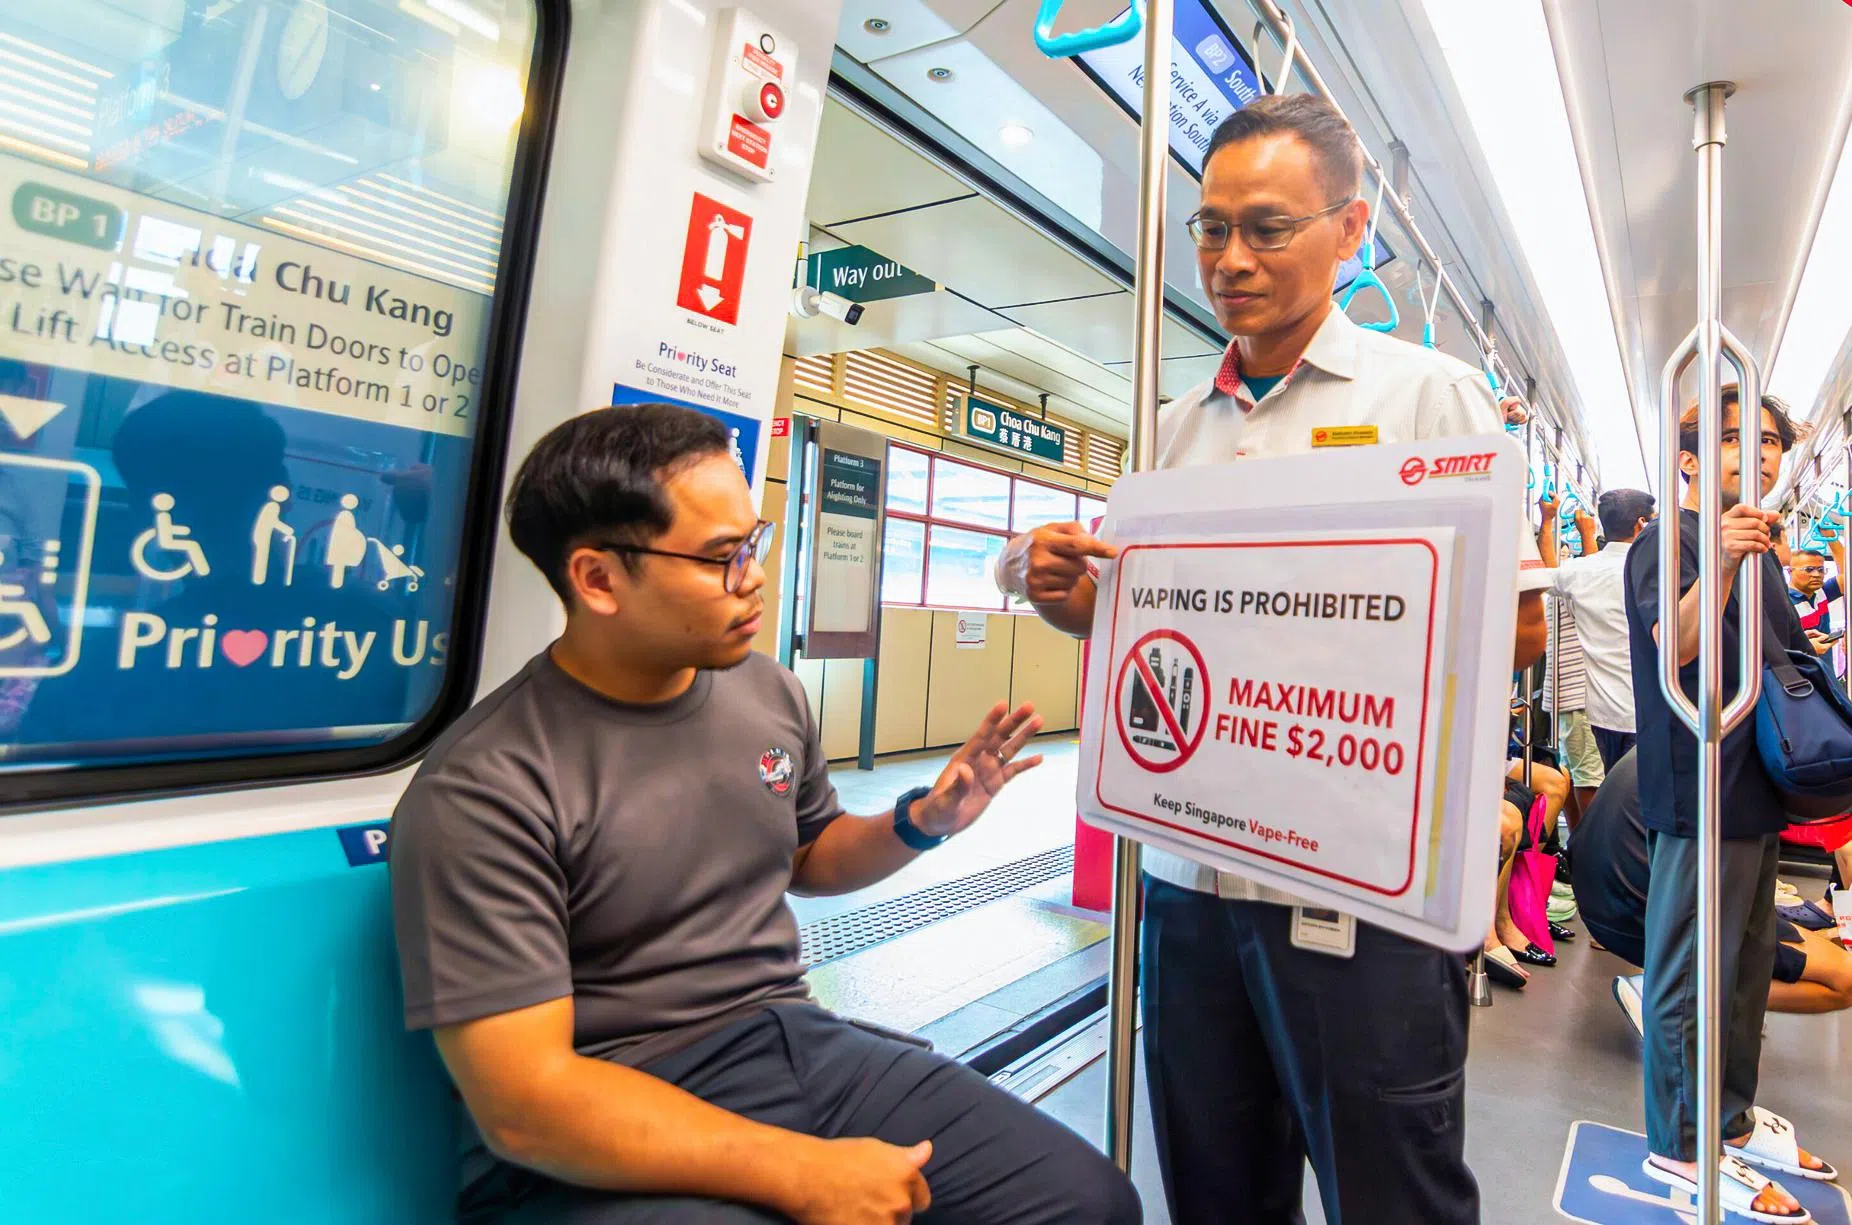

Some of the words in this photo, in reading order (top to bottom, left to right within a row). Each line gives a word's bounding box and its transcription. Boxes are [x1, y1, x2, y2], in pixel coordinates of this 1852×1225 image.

[1204, 42, 1229, 67] BP2
[1192, 99, 1208, 112] A
[1201, 108, 1219, 126] via
[32, 195, 80, 228] BP
[93, 214, 108, 239] 1
[833, 265, 868, 288] Way
[872, 262, 903, 281] out
[275, 261, 350, 306] Chu
[365, 285, 454, 337] Kang
[686, 317, 708, 329] BELOW
[709, 324, 725, 335] SEAT
[220, 302, 296, 344] Train
[306, 322, 391, 365] Doors
[399, 346, 424, 373] to
[433, 353, 482, 387] Ope
[12, 301, 79, 343] Lift
[224, 352, 257, 378] at
[266, 354, 390, 403] Platform
[400, 384, 413, 408] 1
[423, 394, 448, 414] or
[454, 394, 470, 419] 2
[711, 358, 737, 378] Seat
[635, 359, 646, 370] Be
[647, 363, 690, 382] Considerate
[690, 376, 704, 386] and
[705, 379, 722, 391] Offer
[724, 384, 736, 396] This
[738, 389, 752, 400] Seat
[646, 377, 655, 386] to
[657, 378, 680, 392] Those
[680, 385, 696, 397] Who
[698, 390, 715, 402] Need
[723, 396, 740, 408] More
[1000, 411, 1022, 430] Choa
[1023, 419, 1040, 437] Chu
[1040, 425, 1061, 446] Kang
[833, 454, 859, 467] Platform
[860, 459, 864, 468] 3
[1429, 452, 1498, 475] SMRT
[827, 491, 853, 504] Alighting
[853, 495, 866, 505] Only
[830, 478, 856, 491] Platform
[856, 482, 865, 492] for
[827, 526, 846, 537] Please
[846, 529, 864, 539] board
[832, 540, 850, 549] trains
[823, 551, 849, 561] Platform
[859, 554, 864, 563] 2
[1131, 587, 1208, 613] VAPING
[1214, 590, 1234, 614] IS
[1240, 591, 1407, 622] PROHIBITED
[391, 619, 449, 667] Us
[1228, 677, 1395, 729] MAXIMUM
[1215, 713, 1279, 753] FINE
[1285, 723, 1405, 776] $2,000
[1153, 792, 1182, 816] Keep
[1185, 801, 1247, 831] Singapore
[1248, 818, 1320, 852] Vape-Free
[364, 829, 388, 855] P
